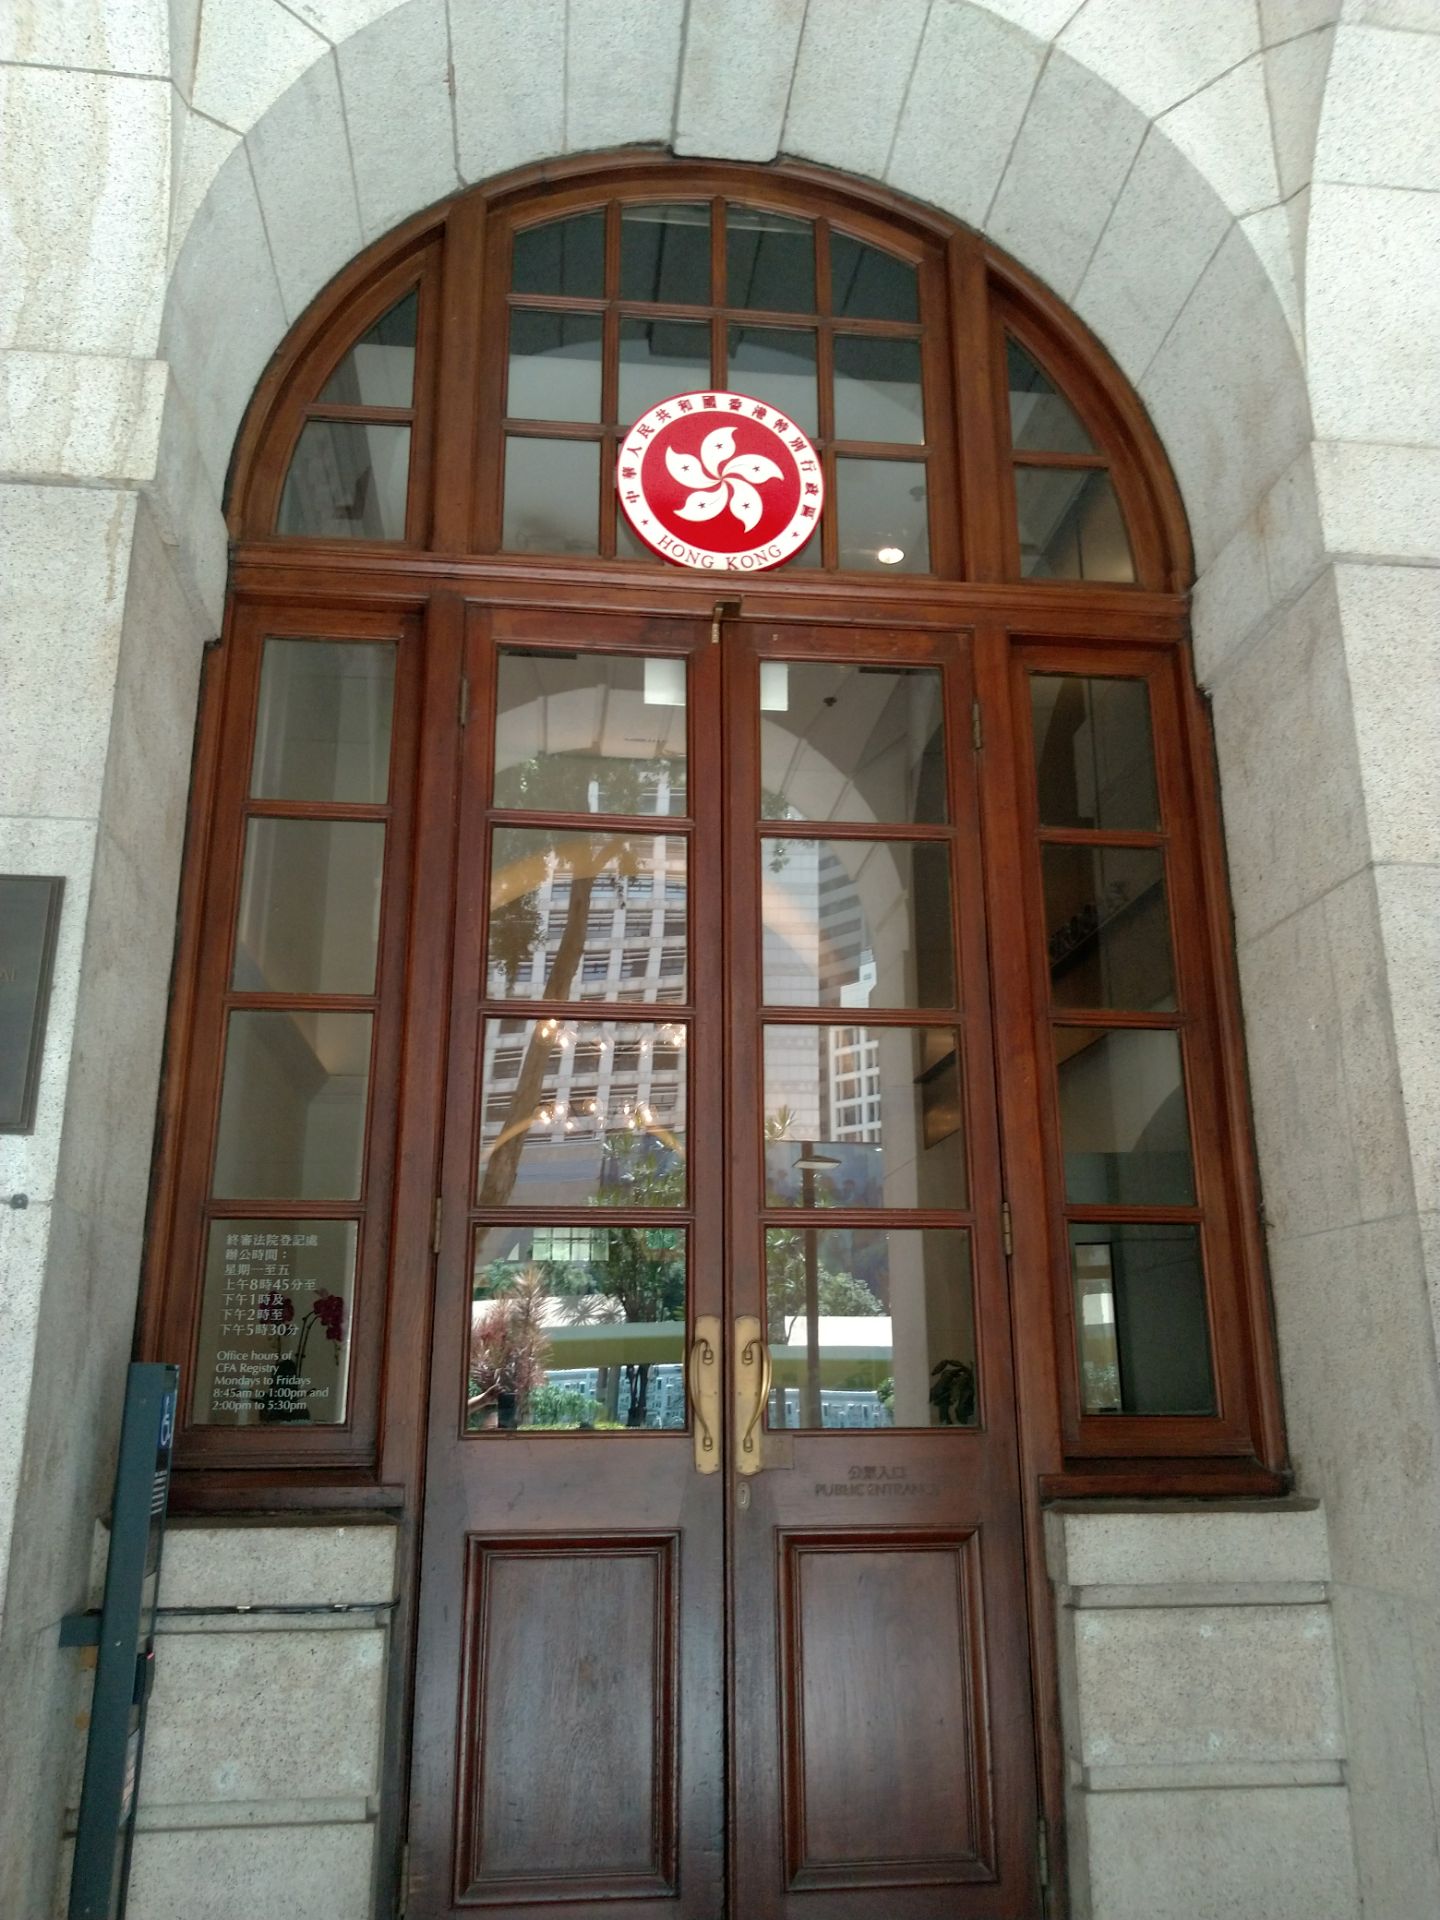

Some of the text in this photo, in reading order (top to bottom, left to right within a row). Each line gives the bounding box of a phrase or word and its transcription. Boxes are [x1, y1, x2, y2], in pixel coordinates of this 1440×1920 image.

[656, 534, 783, 572] HONG KONG
[224, 1263, 290, 1276] 星期一至五
[223, 1278, 317, 1291] 上午8時45分至
[222, 1293, 284, 1305] 下午1時及
[222, 1308, 284, 1321] 下午2時至
[221, 1324, 299, 1336] 下午5時30分
[216, 1350, 293, 1361] Office hours of
[215, 1363, 280, 1375] CFA Registry
[214, 1375, 312, 1387] Mondays to Fridays
[213, 1387, 329, 1400] 8:45am to 1:00pm and
[212, 1400, 306, 1413] 2:00pm to 5:30pm
[815, 1483, 865, 1497] PUBLIC
